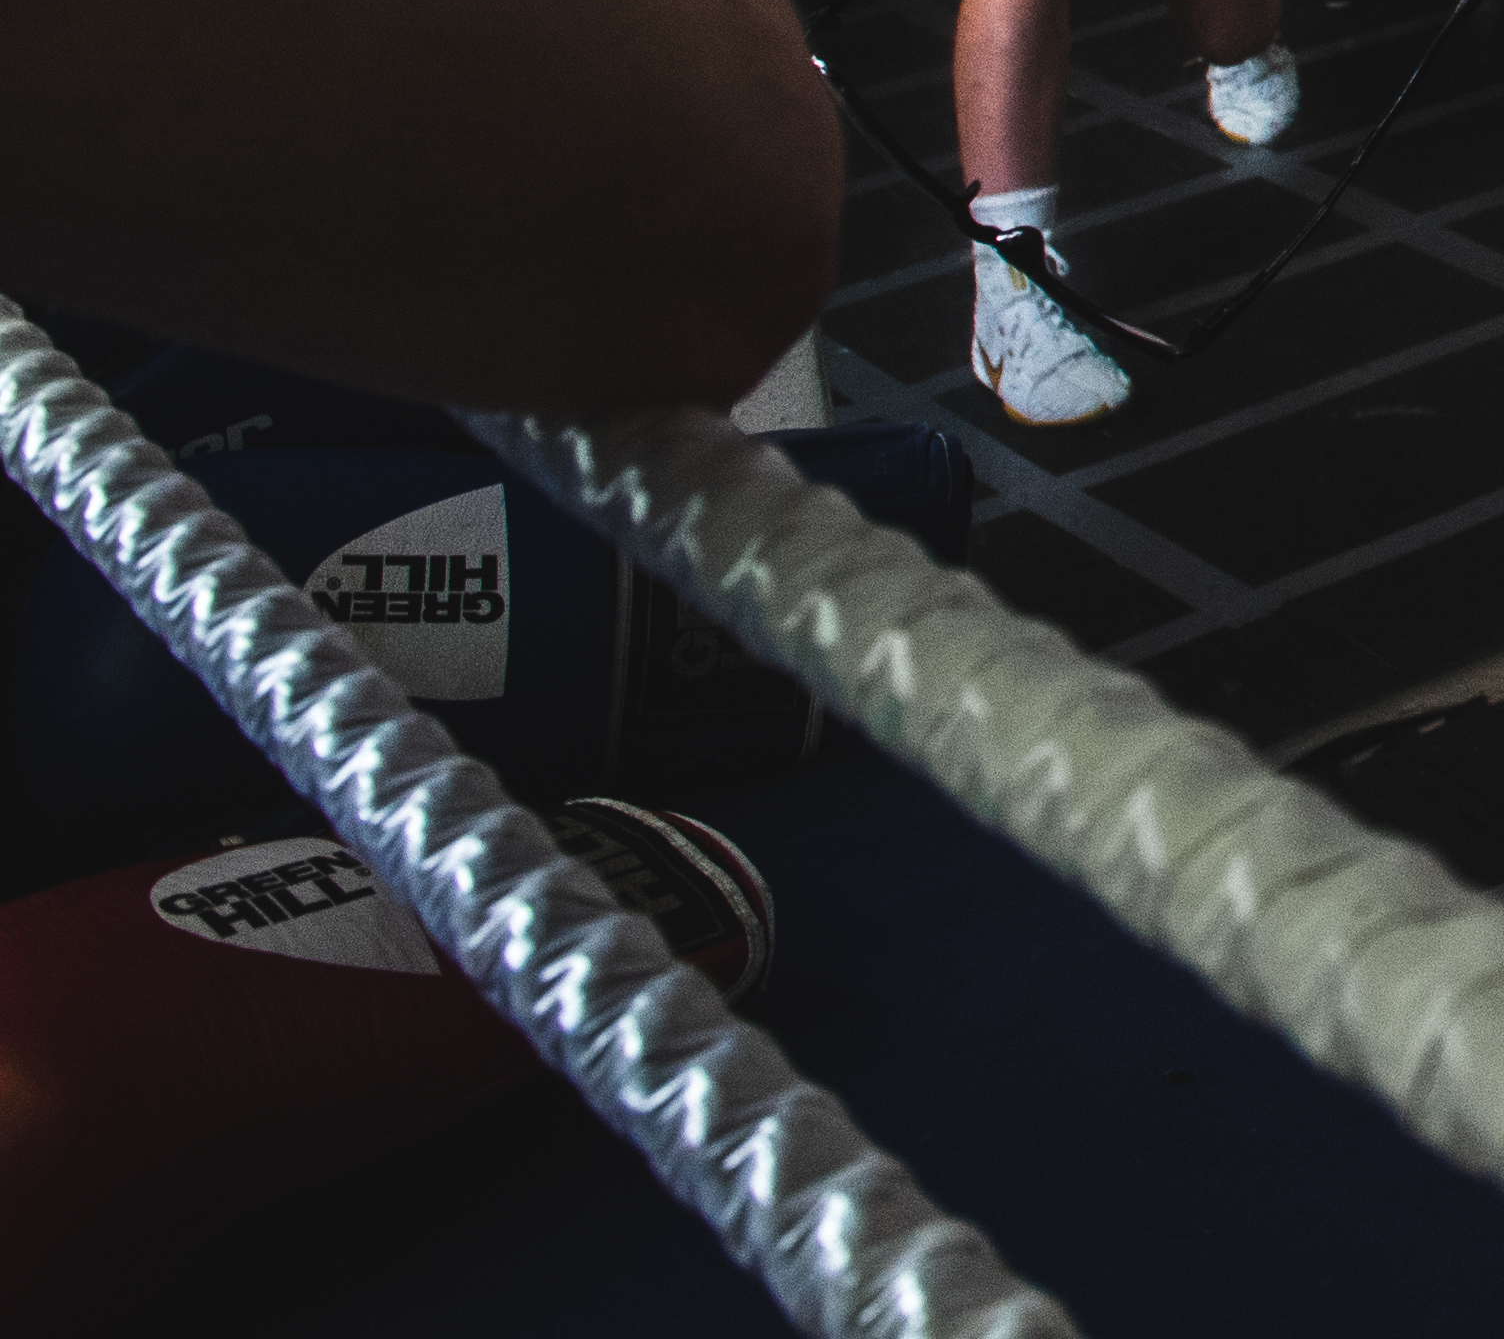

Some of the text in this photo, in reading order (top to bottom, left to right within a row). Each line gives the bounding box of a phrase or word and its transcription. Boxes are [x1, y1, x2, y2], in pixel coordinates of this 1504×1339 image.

[341, 554, 498, 592] HILL
[311, 591, 505, 624] GREEN
[159, 850, 364, 916] GREEN
[197, 875, 377, 939] HILL
